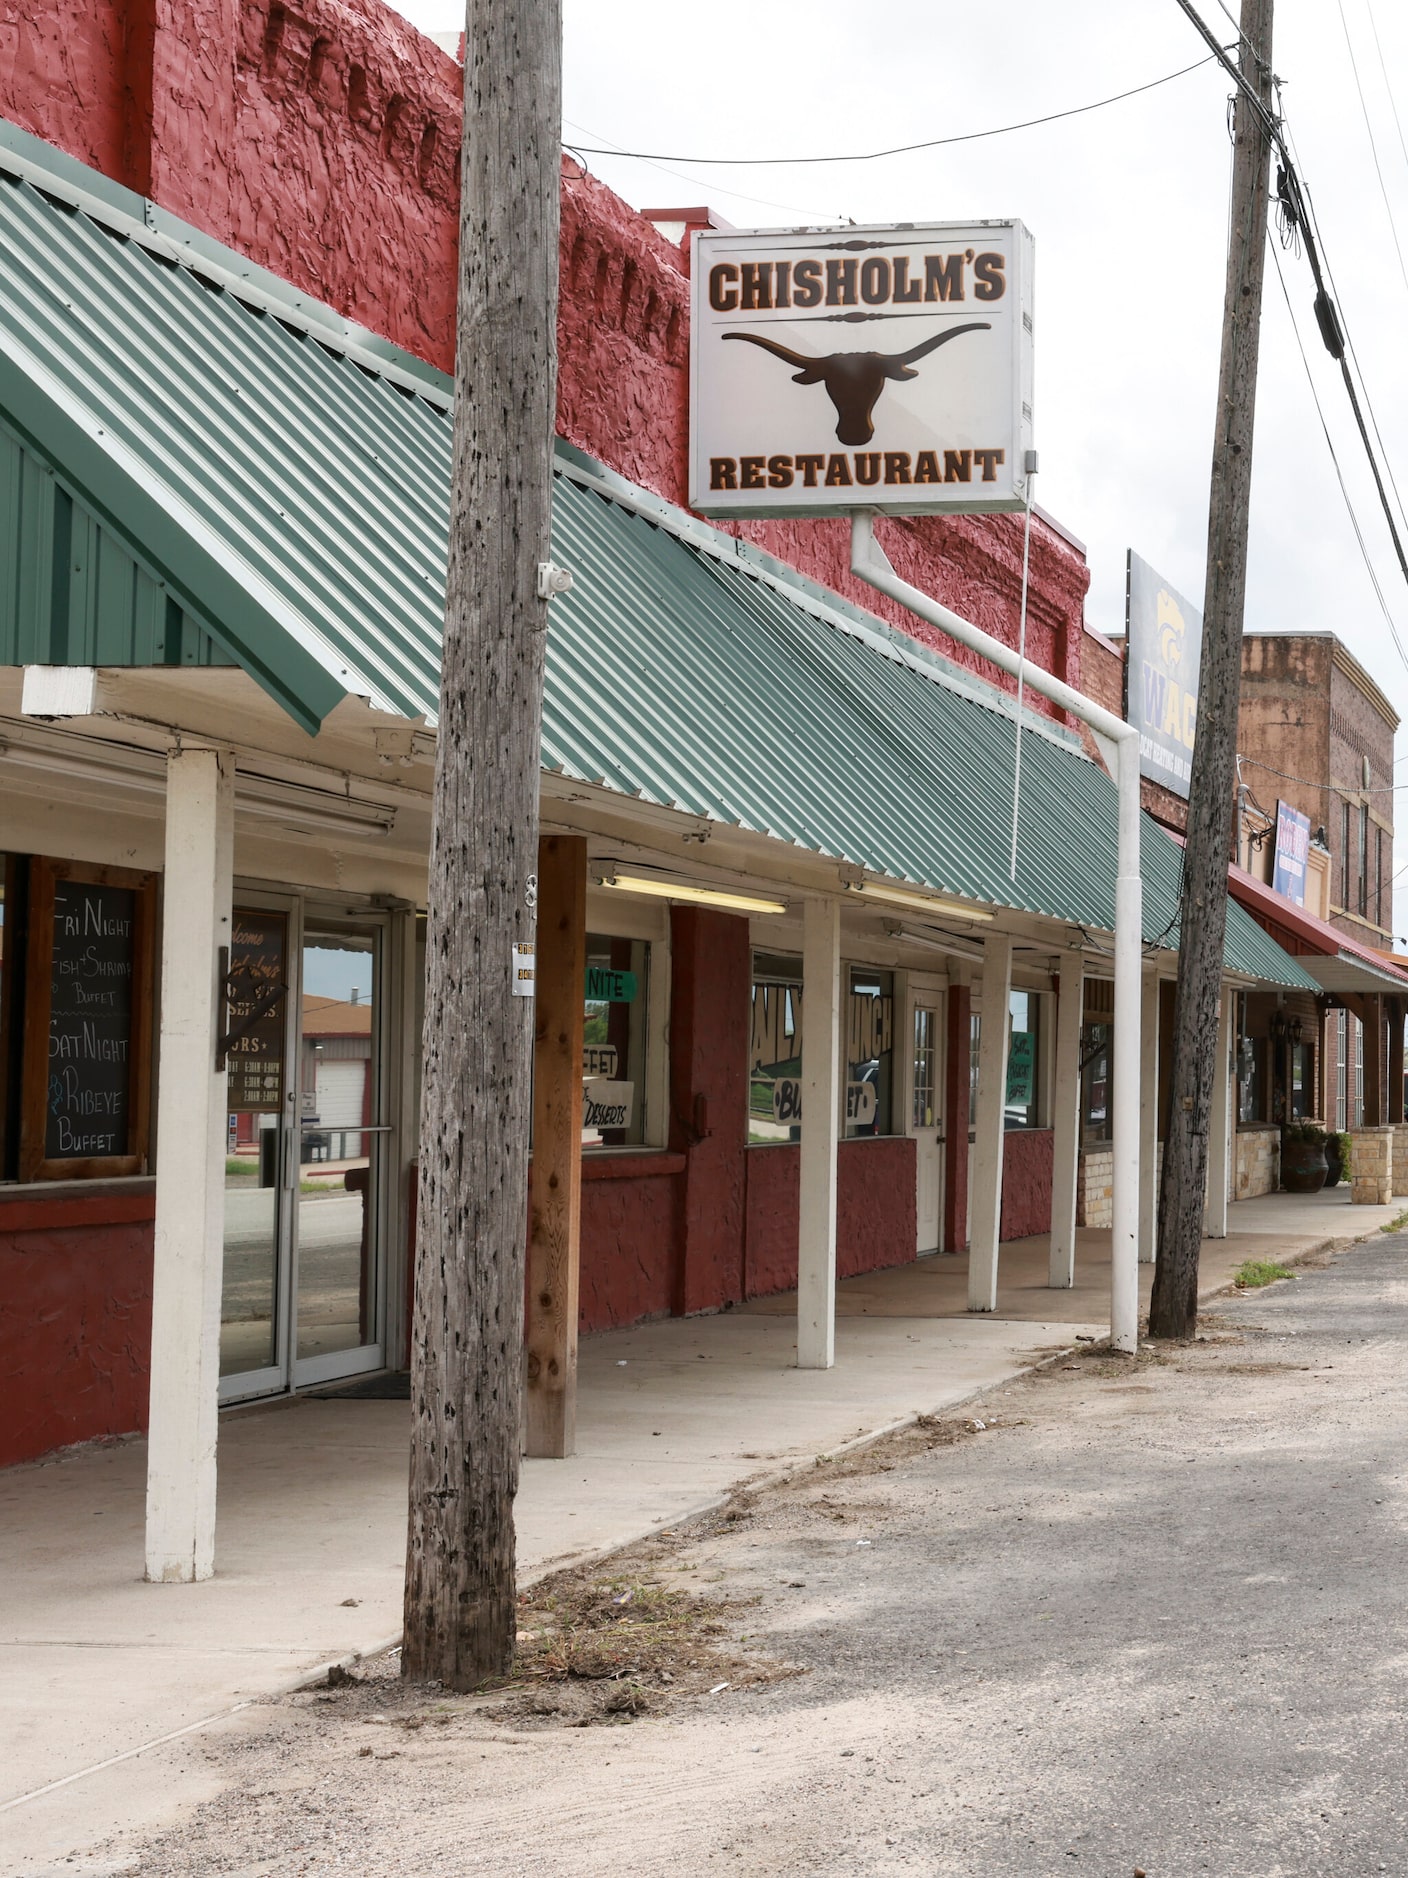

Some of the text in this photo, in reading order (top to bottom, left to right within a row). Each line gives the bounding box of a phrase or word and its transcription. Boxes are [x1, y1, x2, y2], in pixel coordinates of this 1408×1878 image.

[709, 249, 1006, 312] CHISHOLM'S
[710, 449, 1005, 490] RESTAURANT
[588, 968, 624, 997] NITE
[83, 1020, 128, 1062] NIGHT
[751, 982, 893, 1074] AILY UNCH
[63, 1065, 122, 1115] RIBEYE
[584, 1100, 627, 1127] DESSERTS
